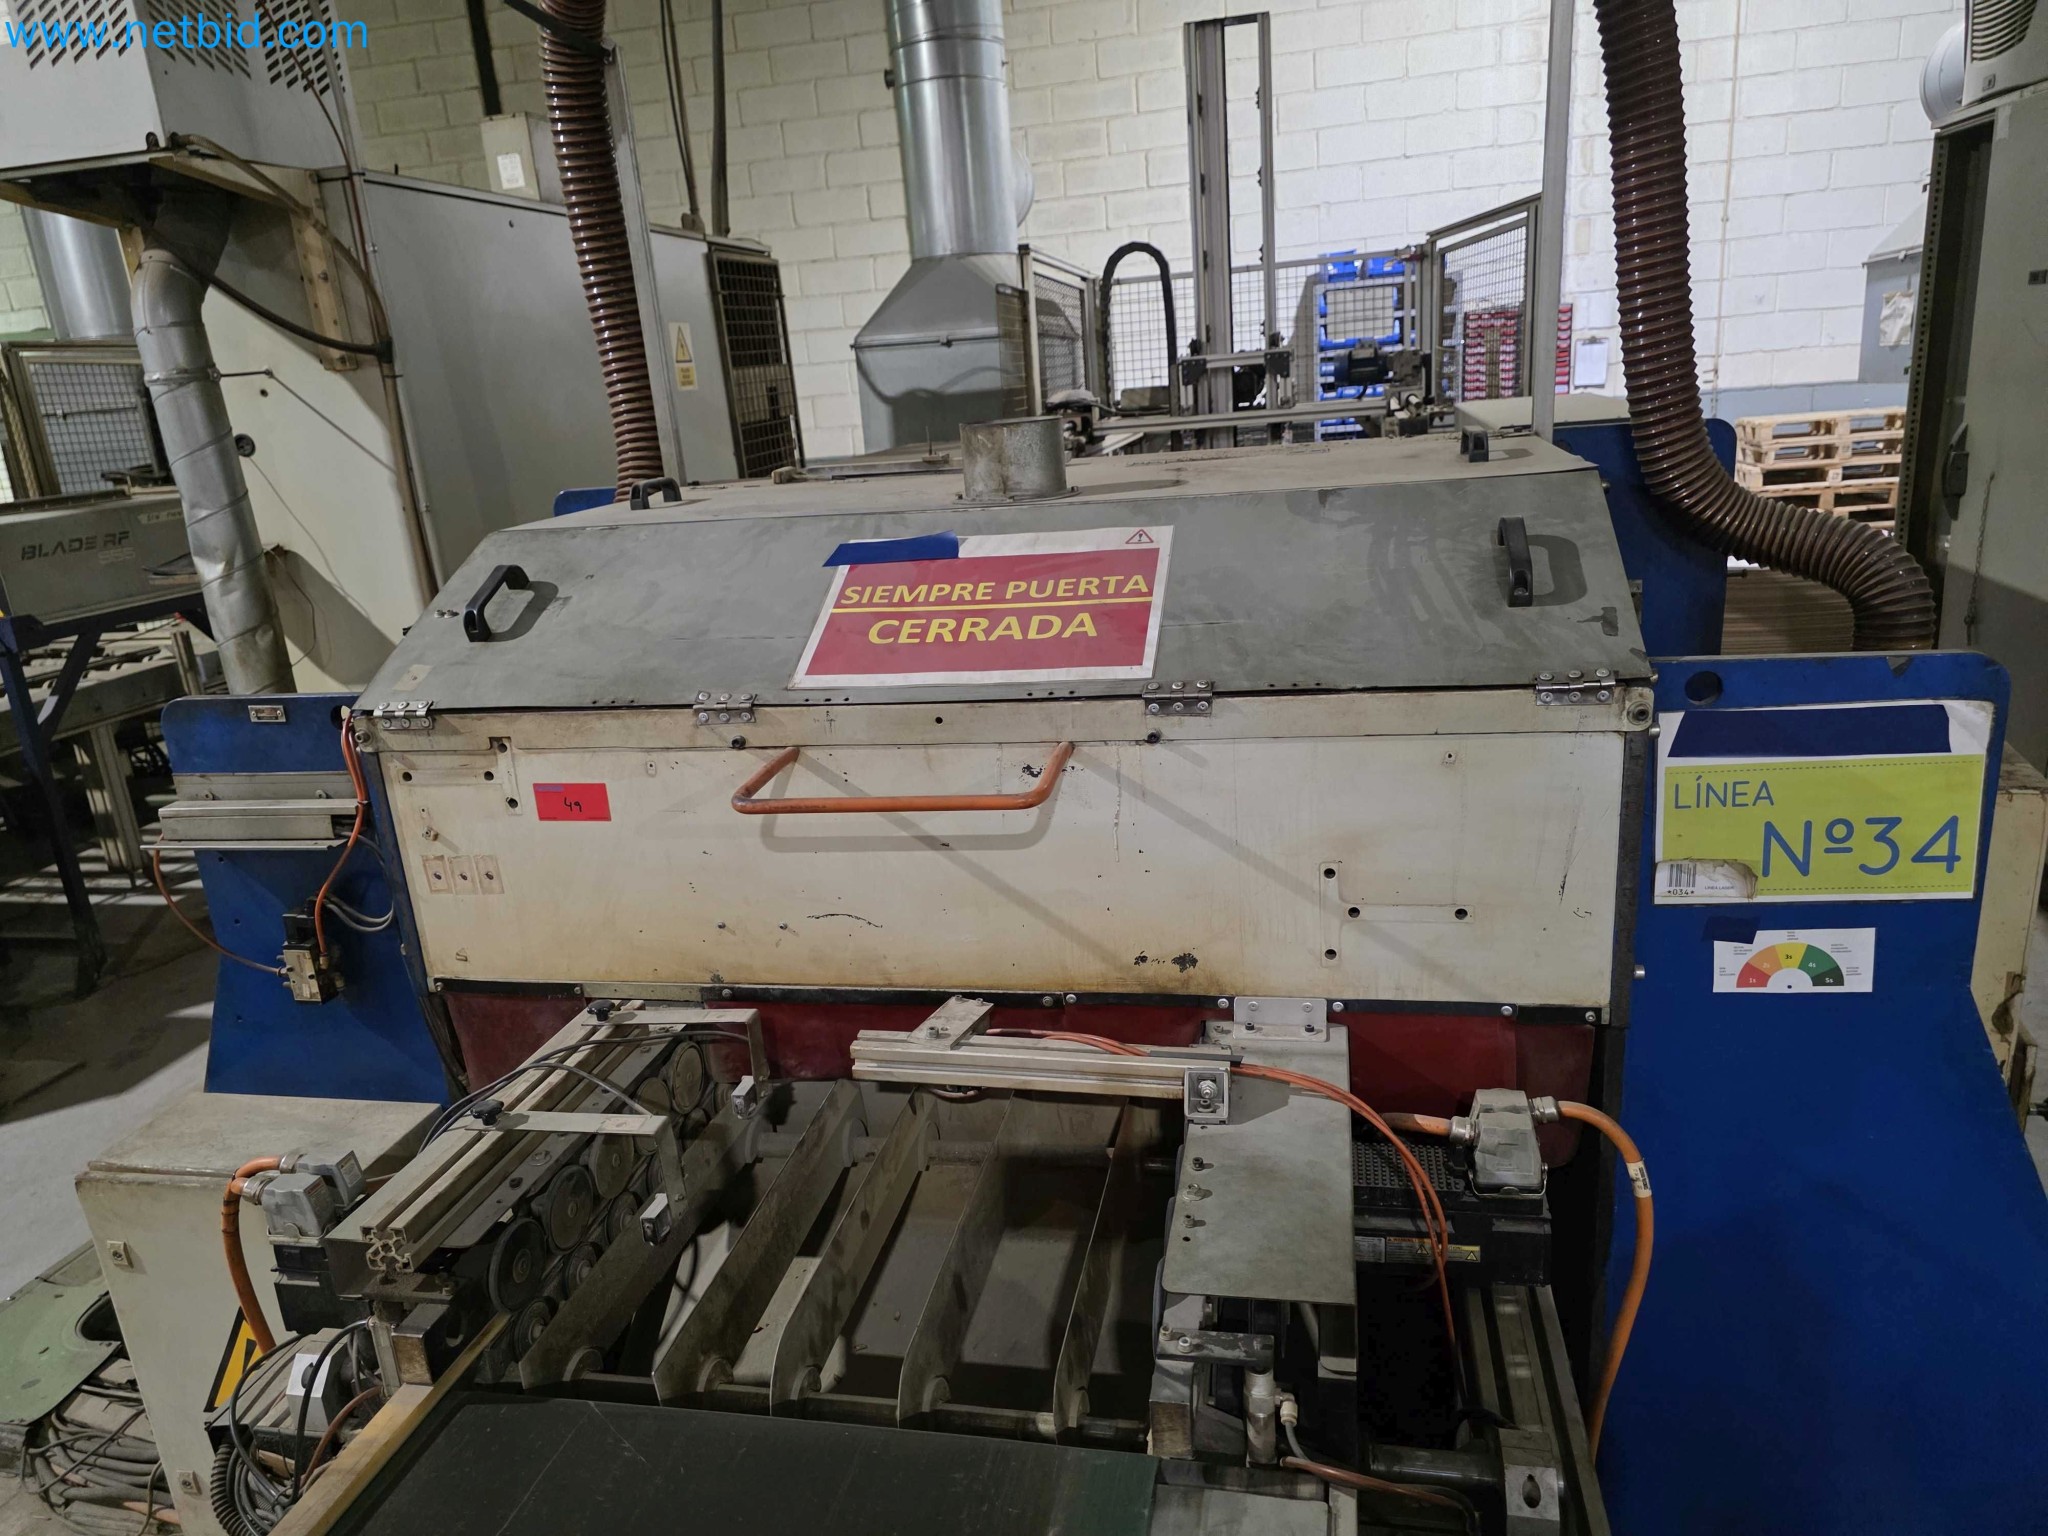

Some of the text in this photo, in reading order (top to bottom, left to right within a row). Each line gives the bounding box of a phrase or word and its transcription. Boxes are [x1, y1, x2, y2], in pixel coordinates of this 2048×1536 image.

[21, 535, 98, 561] BLADE
[840, 574, 1149, 605] SIEMPRE PUERTA
[867, 612, 1098, 644] CERRADA
[563, 796, 582, 813] 49
[1674, 775, 1775, 809] LÍNEA
